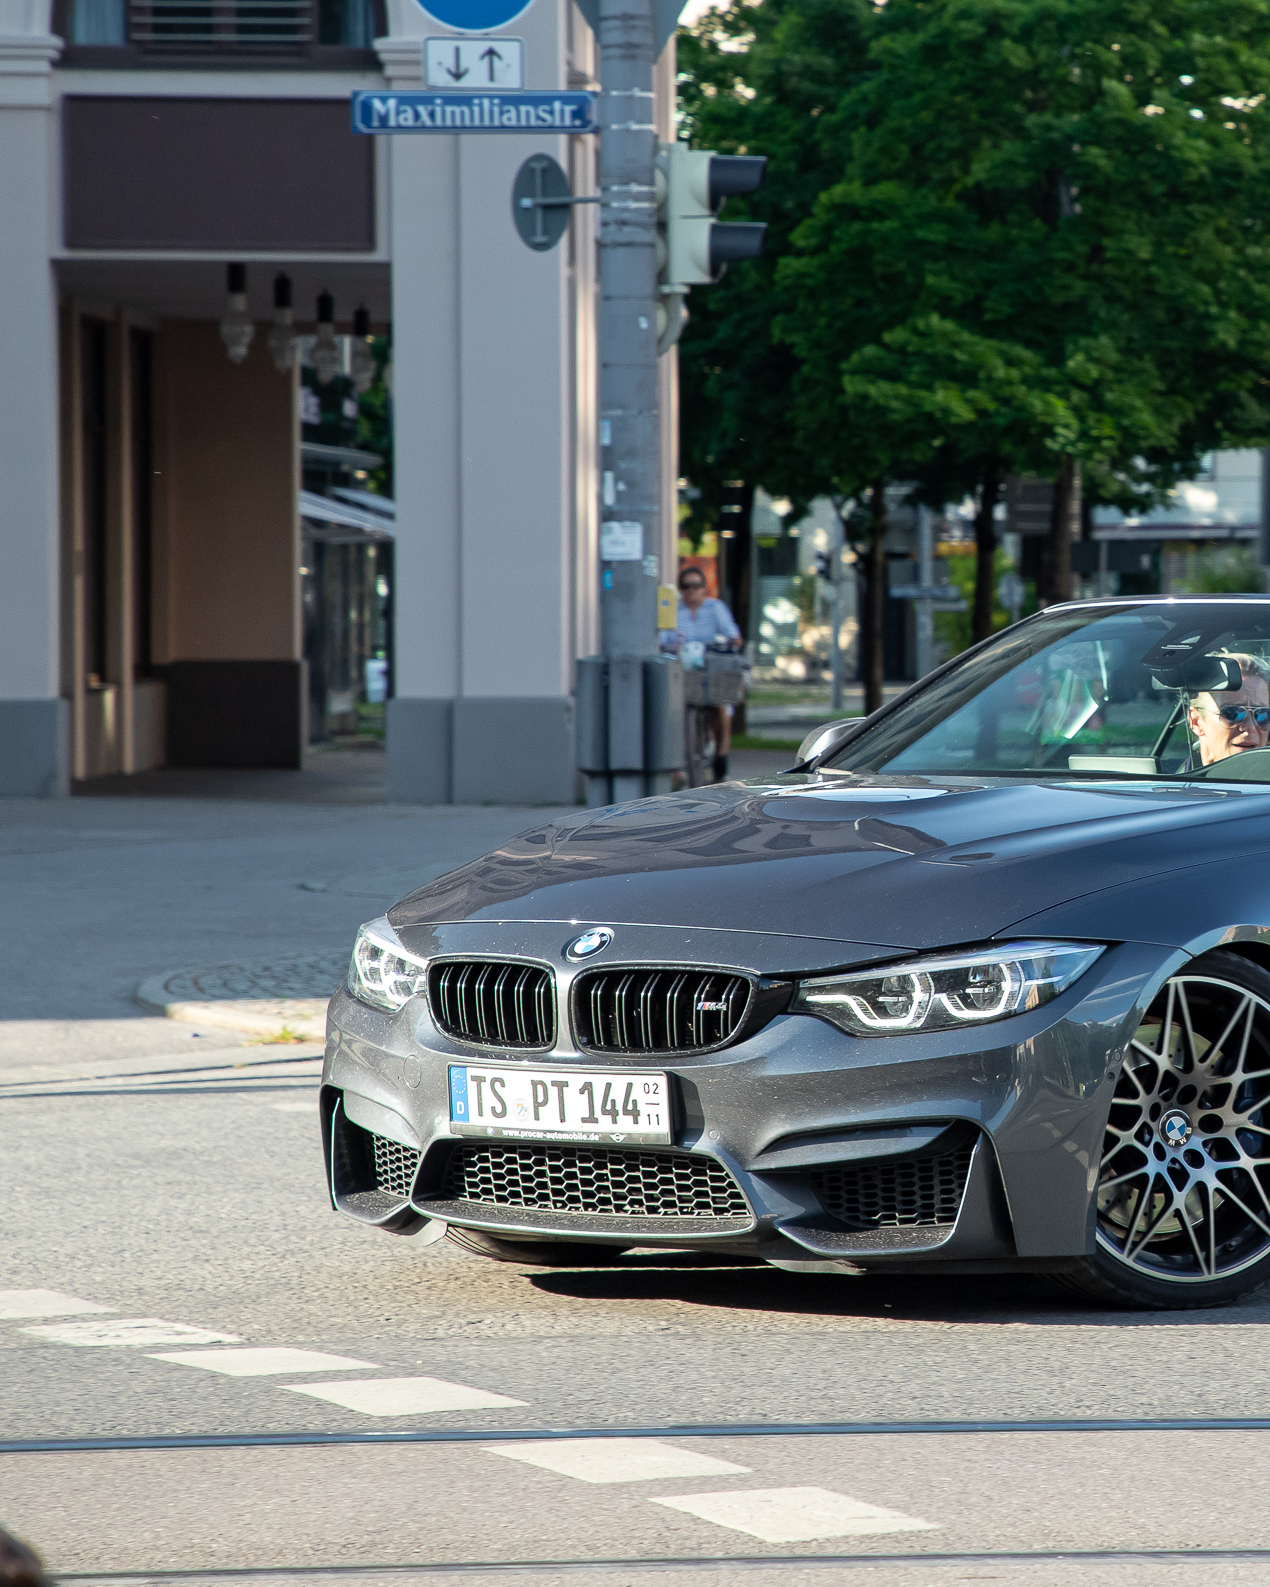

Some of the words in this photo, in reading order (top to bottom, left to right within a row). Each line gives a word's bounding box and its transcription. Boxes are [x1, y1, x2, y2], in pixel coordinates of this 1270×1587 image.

[371, 97, 582, 127] Maximilianstr.
[643, 1082, 660, 1095] 02
[470, 1075, 507, 1118] TS
[530, 1079, 569, 1123] PT
[579, 1081, 640, 1124] 144
[456, 1101, 465, 1115] D
[646, 1113, 660, 1126] 11
[502, 1129, 599, 1141] www.procar-automobile.de
